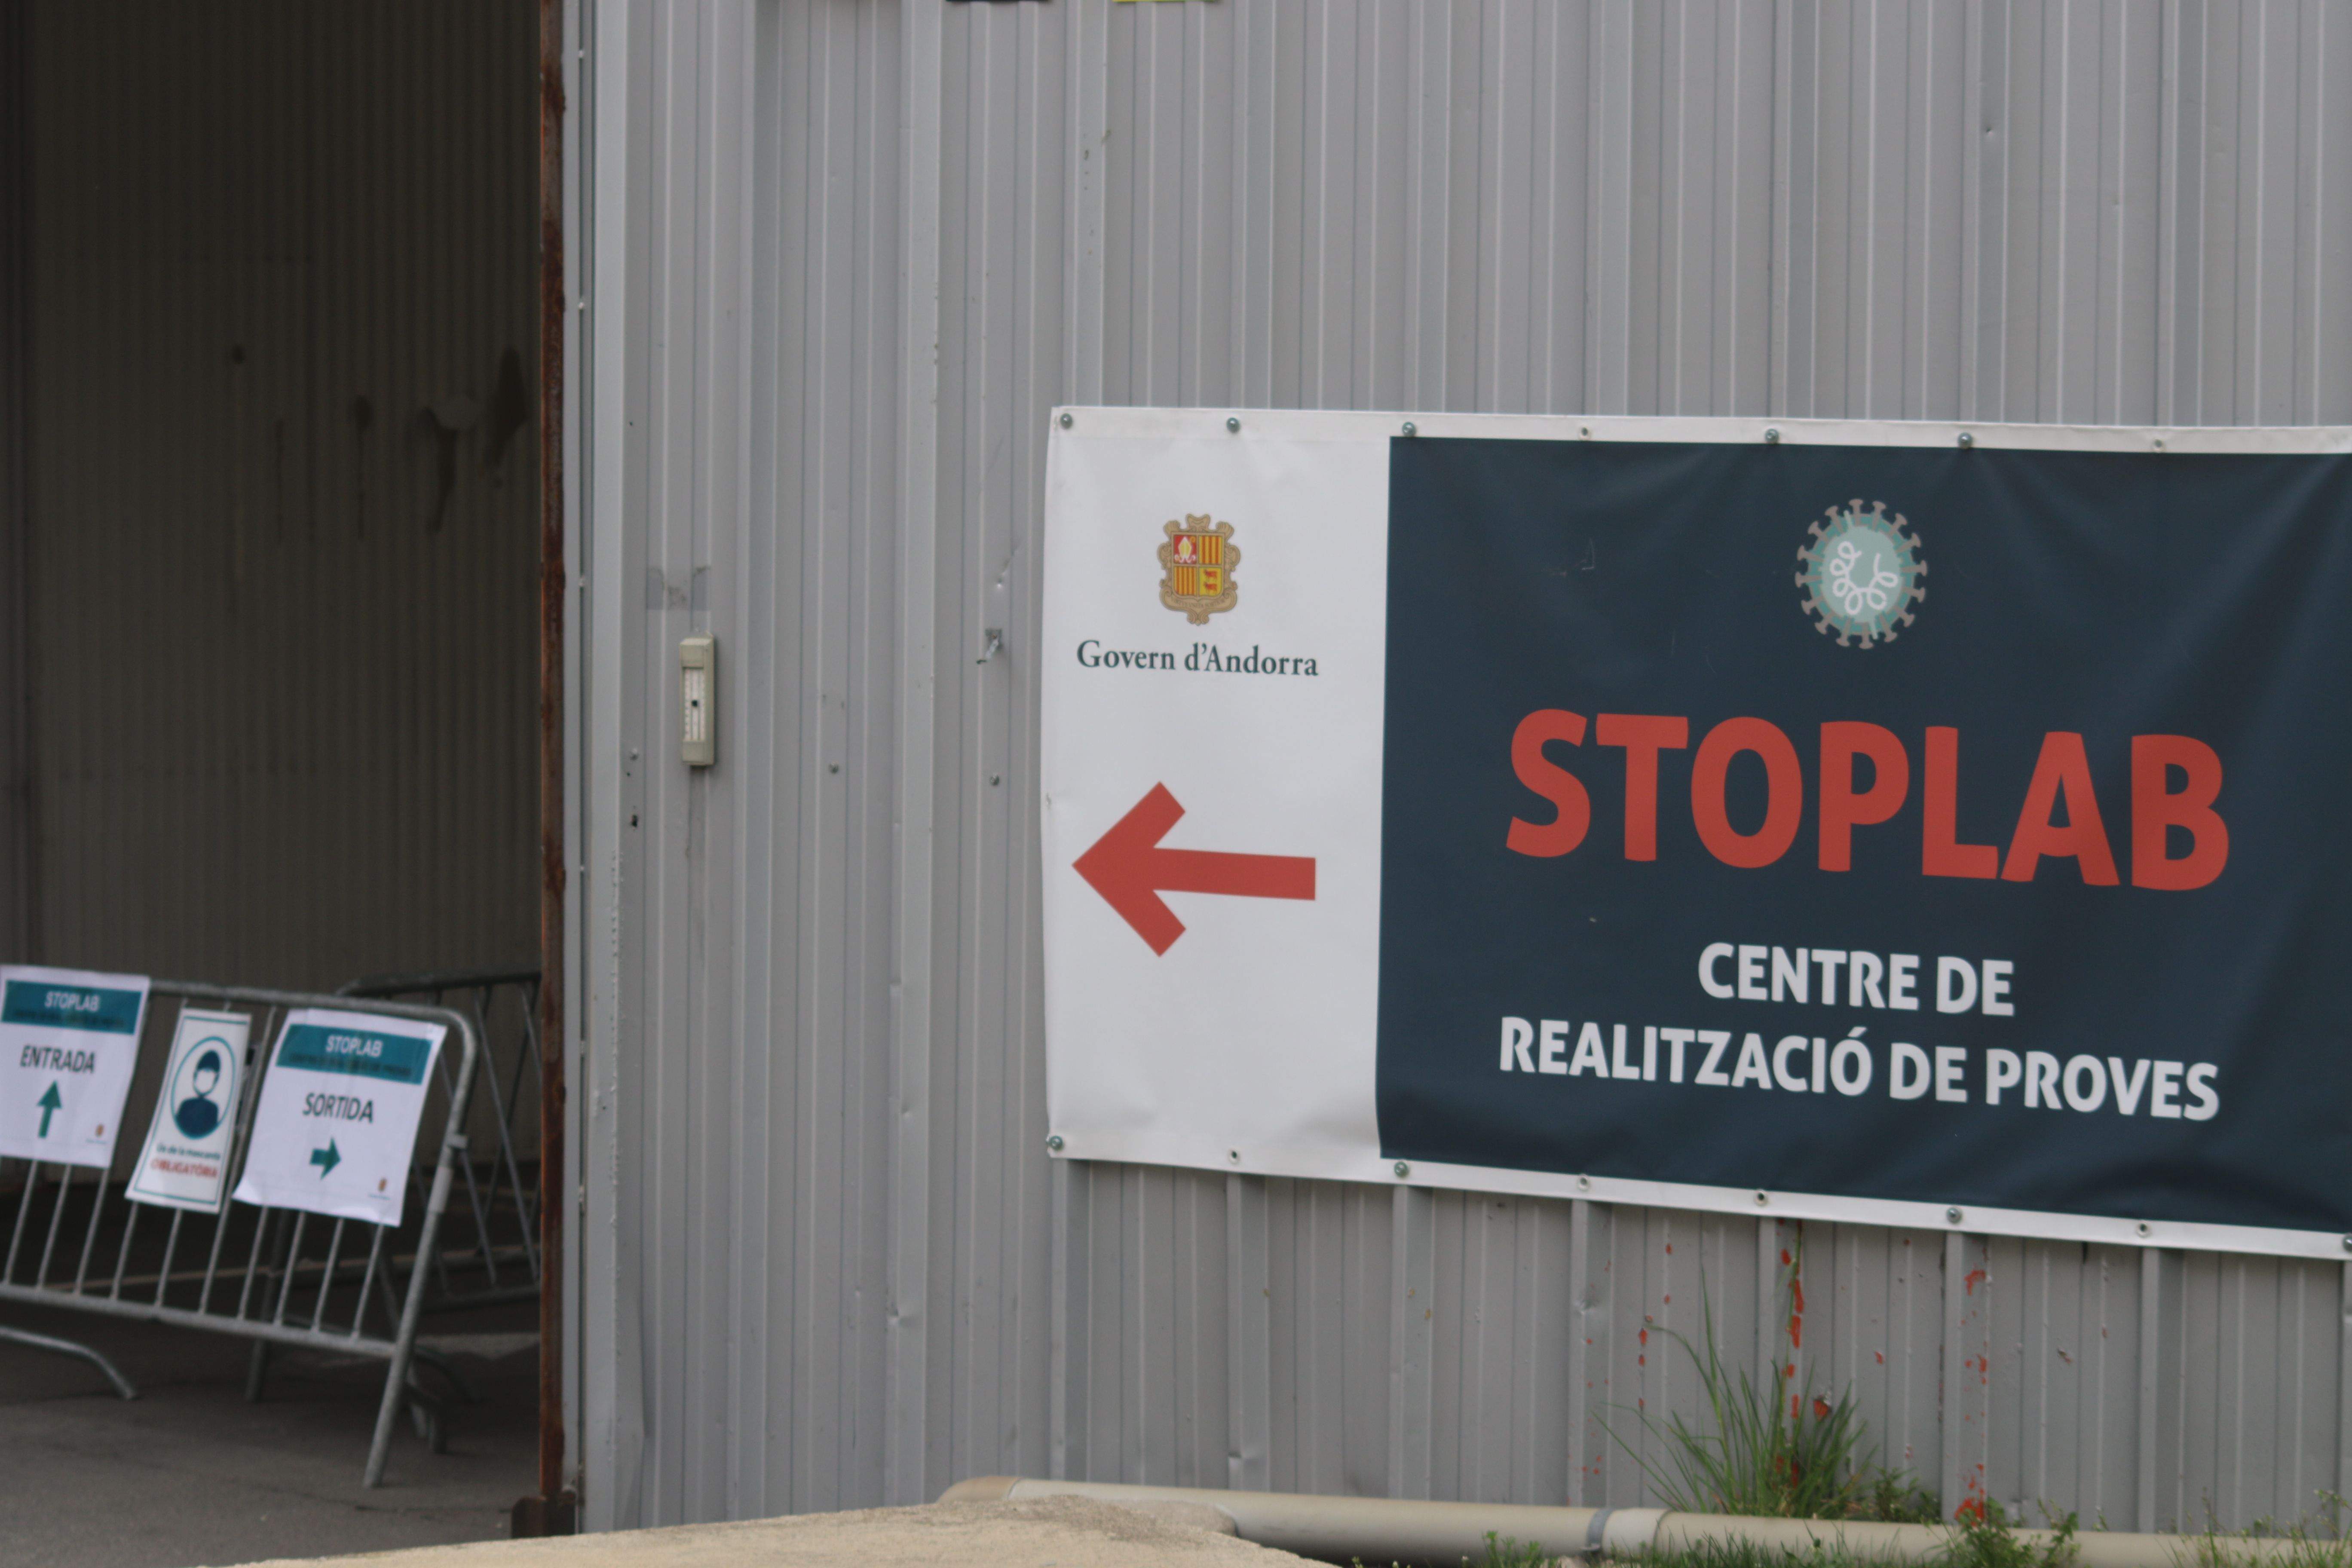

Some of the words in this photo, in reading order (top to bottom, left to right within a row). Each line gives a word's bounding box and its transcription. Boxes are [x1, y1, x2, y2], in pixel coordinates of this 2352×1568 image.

[1077, 639, 1176, 670] Govern
[1184, 642, 1319, 677] d'Andorra
[1506, 708, 2230, 891] STOPLAB
[1698, 942, 1920, 1011] CENTRE
[1936, 956, 2014, 1016] DE
[45, 992, 101, 1012] STOPLAB
[21, 1045, 95, 1074] ENTRADA
[325, 1035, 383, 1058] STOPLAB
[1499, 1016, 1872, 1096] REALITZACIÓ
[1889, 1042, 1967, 1102] DE
[1986, 1048, 2219, 1121] PROVES
[303, 1093, 374, 1123] SORTIDA
